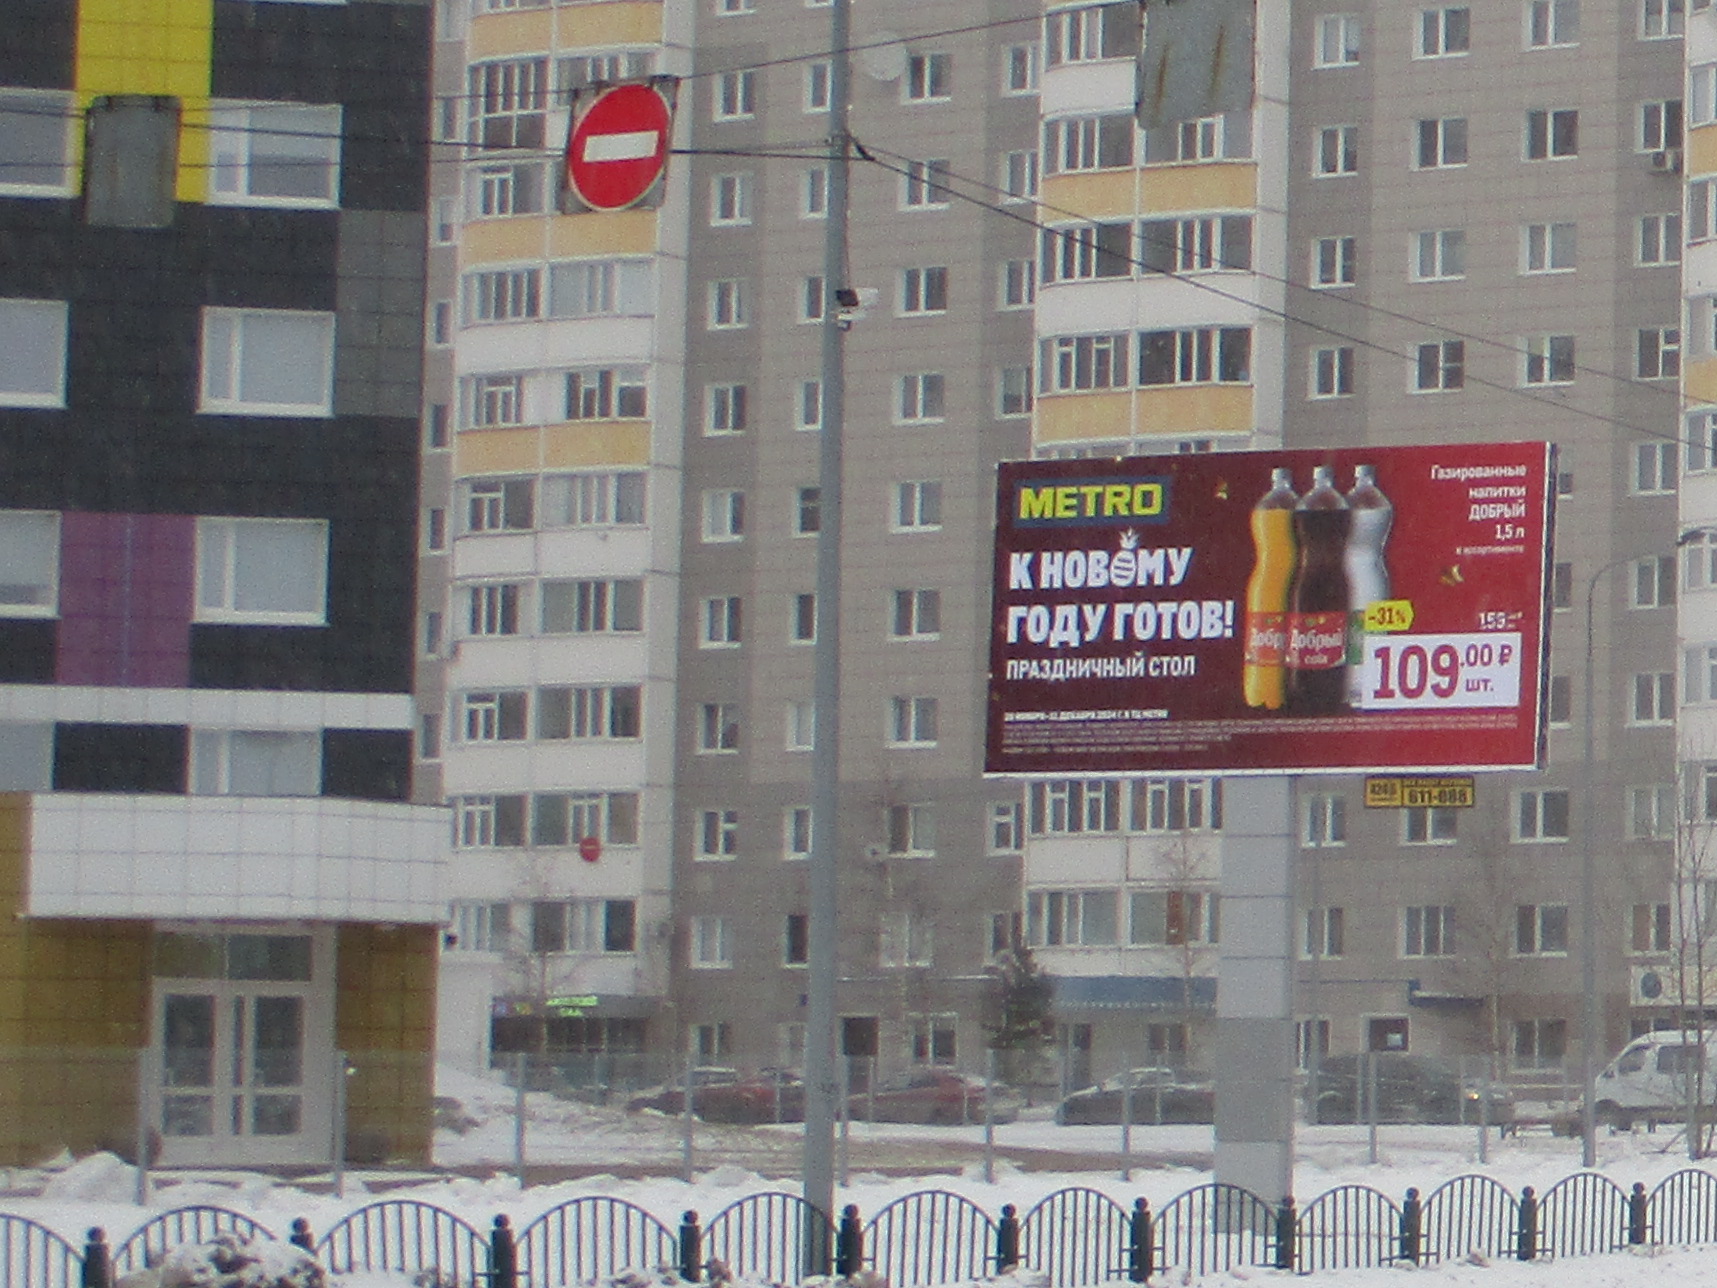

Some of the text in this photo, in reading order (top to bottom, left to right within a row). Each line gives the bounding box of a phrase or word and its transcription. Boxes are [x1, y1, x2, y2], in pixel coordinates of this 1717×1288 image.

[1431, 464, 1527, 481] Газированные
[1019, 483, 1163, 519] METRO
[1469, 486, 1526, 498] напитки
[1468, 499, 1525, 521] ДОБРЫЙ
[1496, 523, 1525, 540] 1,5 л
[1009, 547, 1194, 590] К НОВОМУ
[1007, 600, 1234, 648] ГОДУ ГОТОВ!
[1007, 651, 1196, 681] ПРАЗДНИЧНЫЙ СТОЛ
[1465, 678, 1494, 692] шт.
